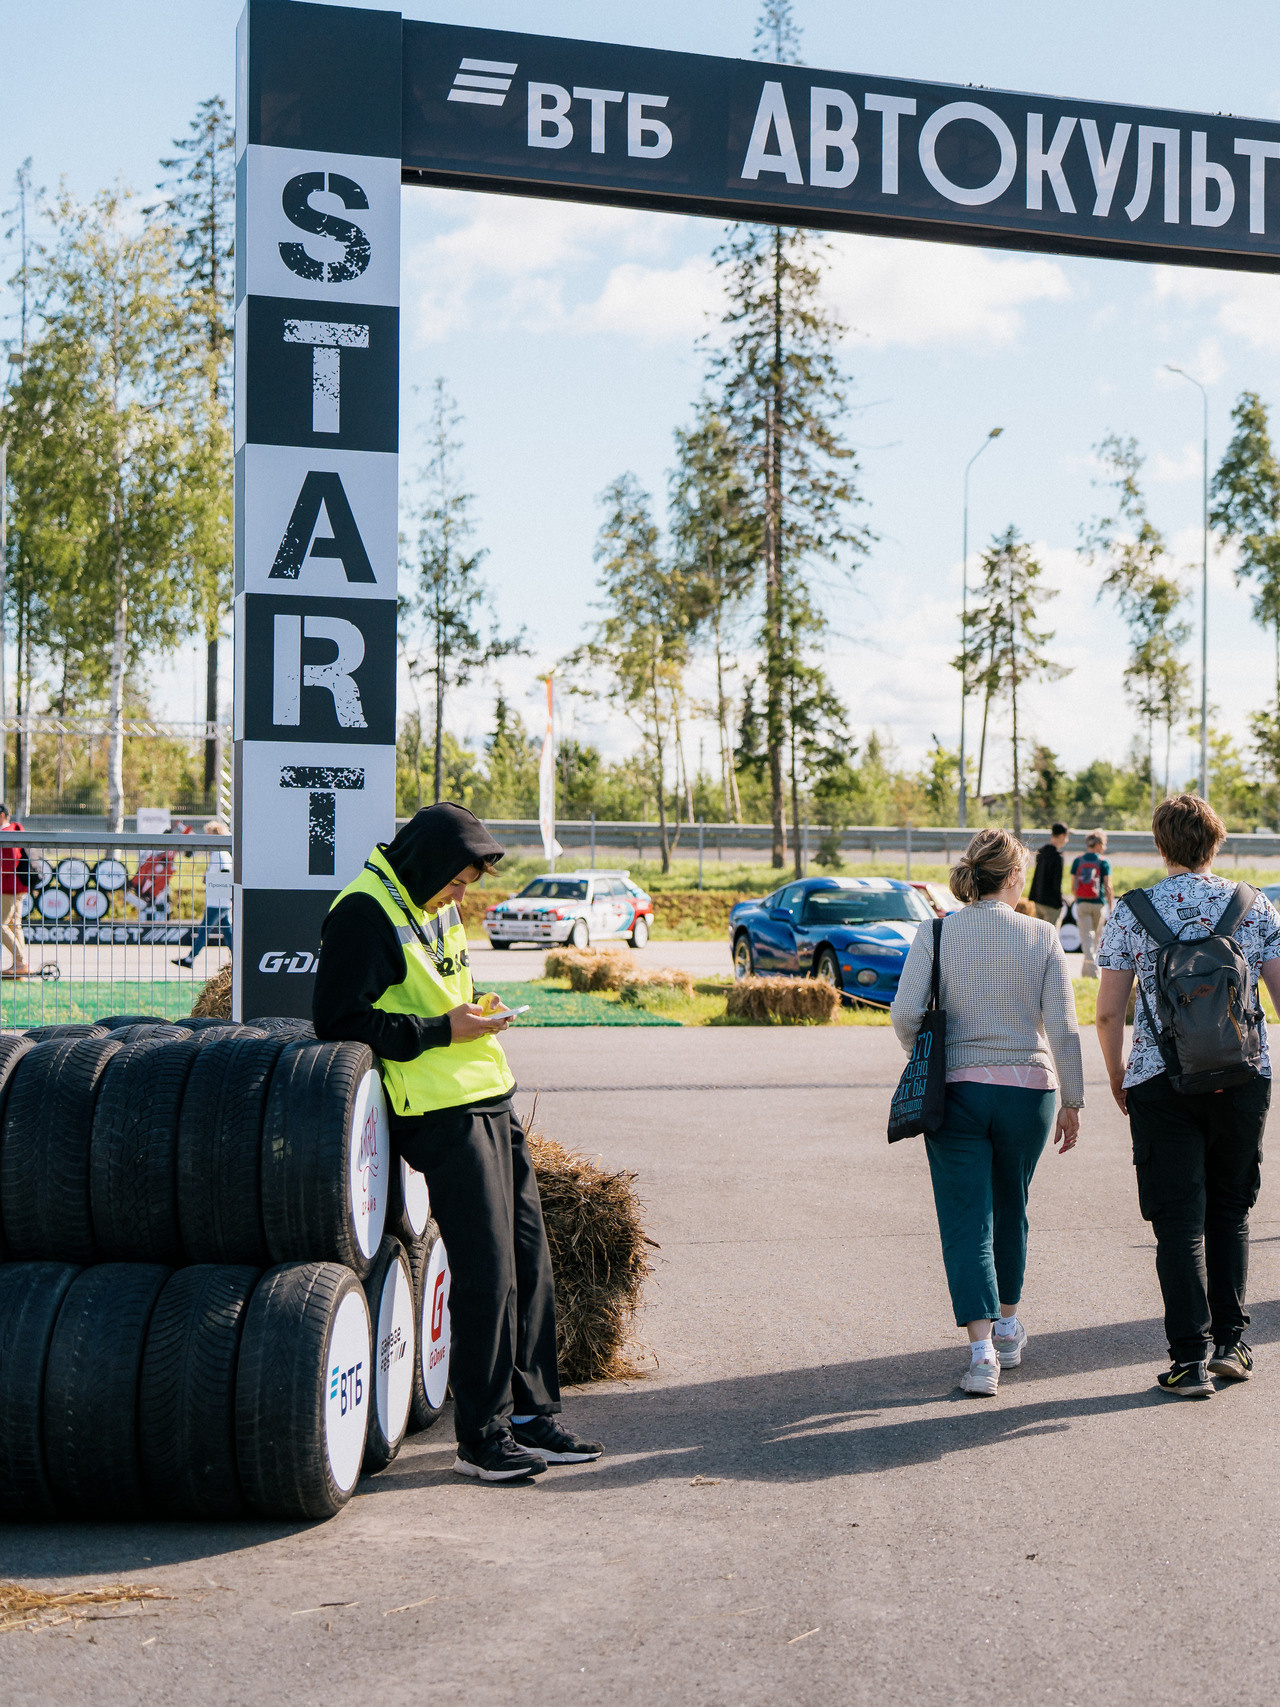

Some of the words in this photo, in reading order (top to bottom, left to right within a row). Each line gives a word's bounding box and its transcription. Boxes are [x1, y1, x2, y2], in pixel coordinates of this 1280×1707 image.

[527, 80, 674, 159] ВТБ
[267, 171, 378, 876] START
[340, 1361, 363, 1418] ВТБ
